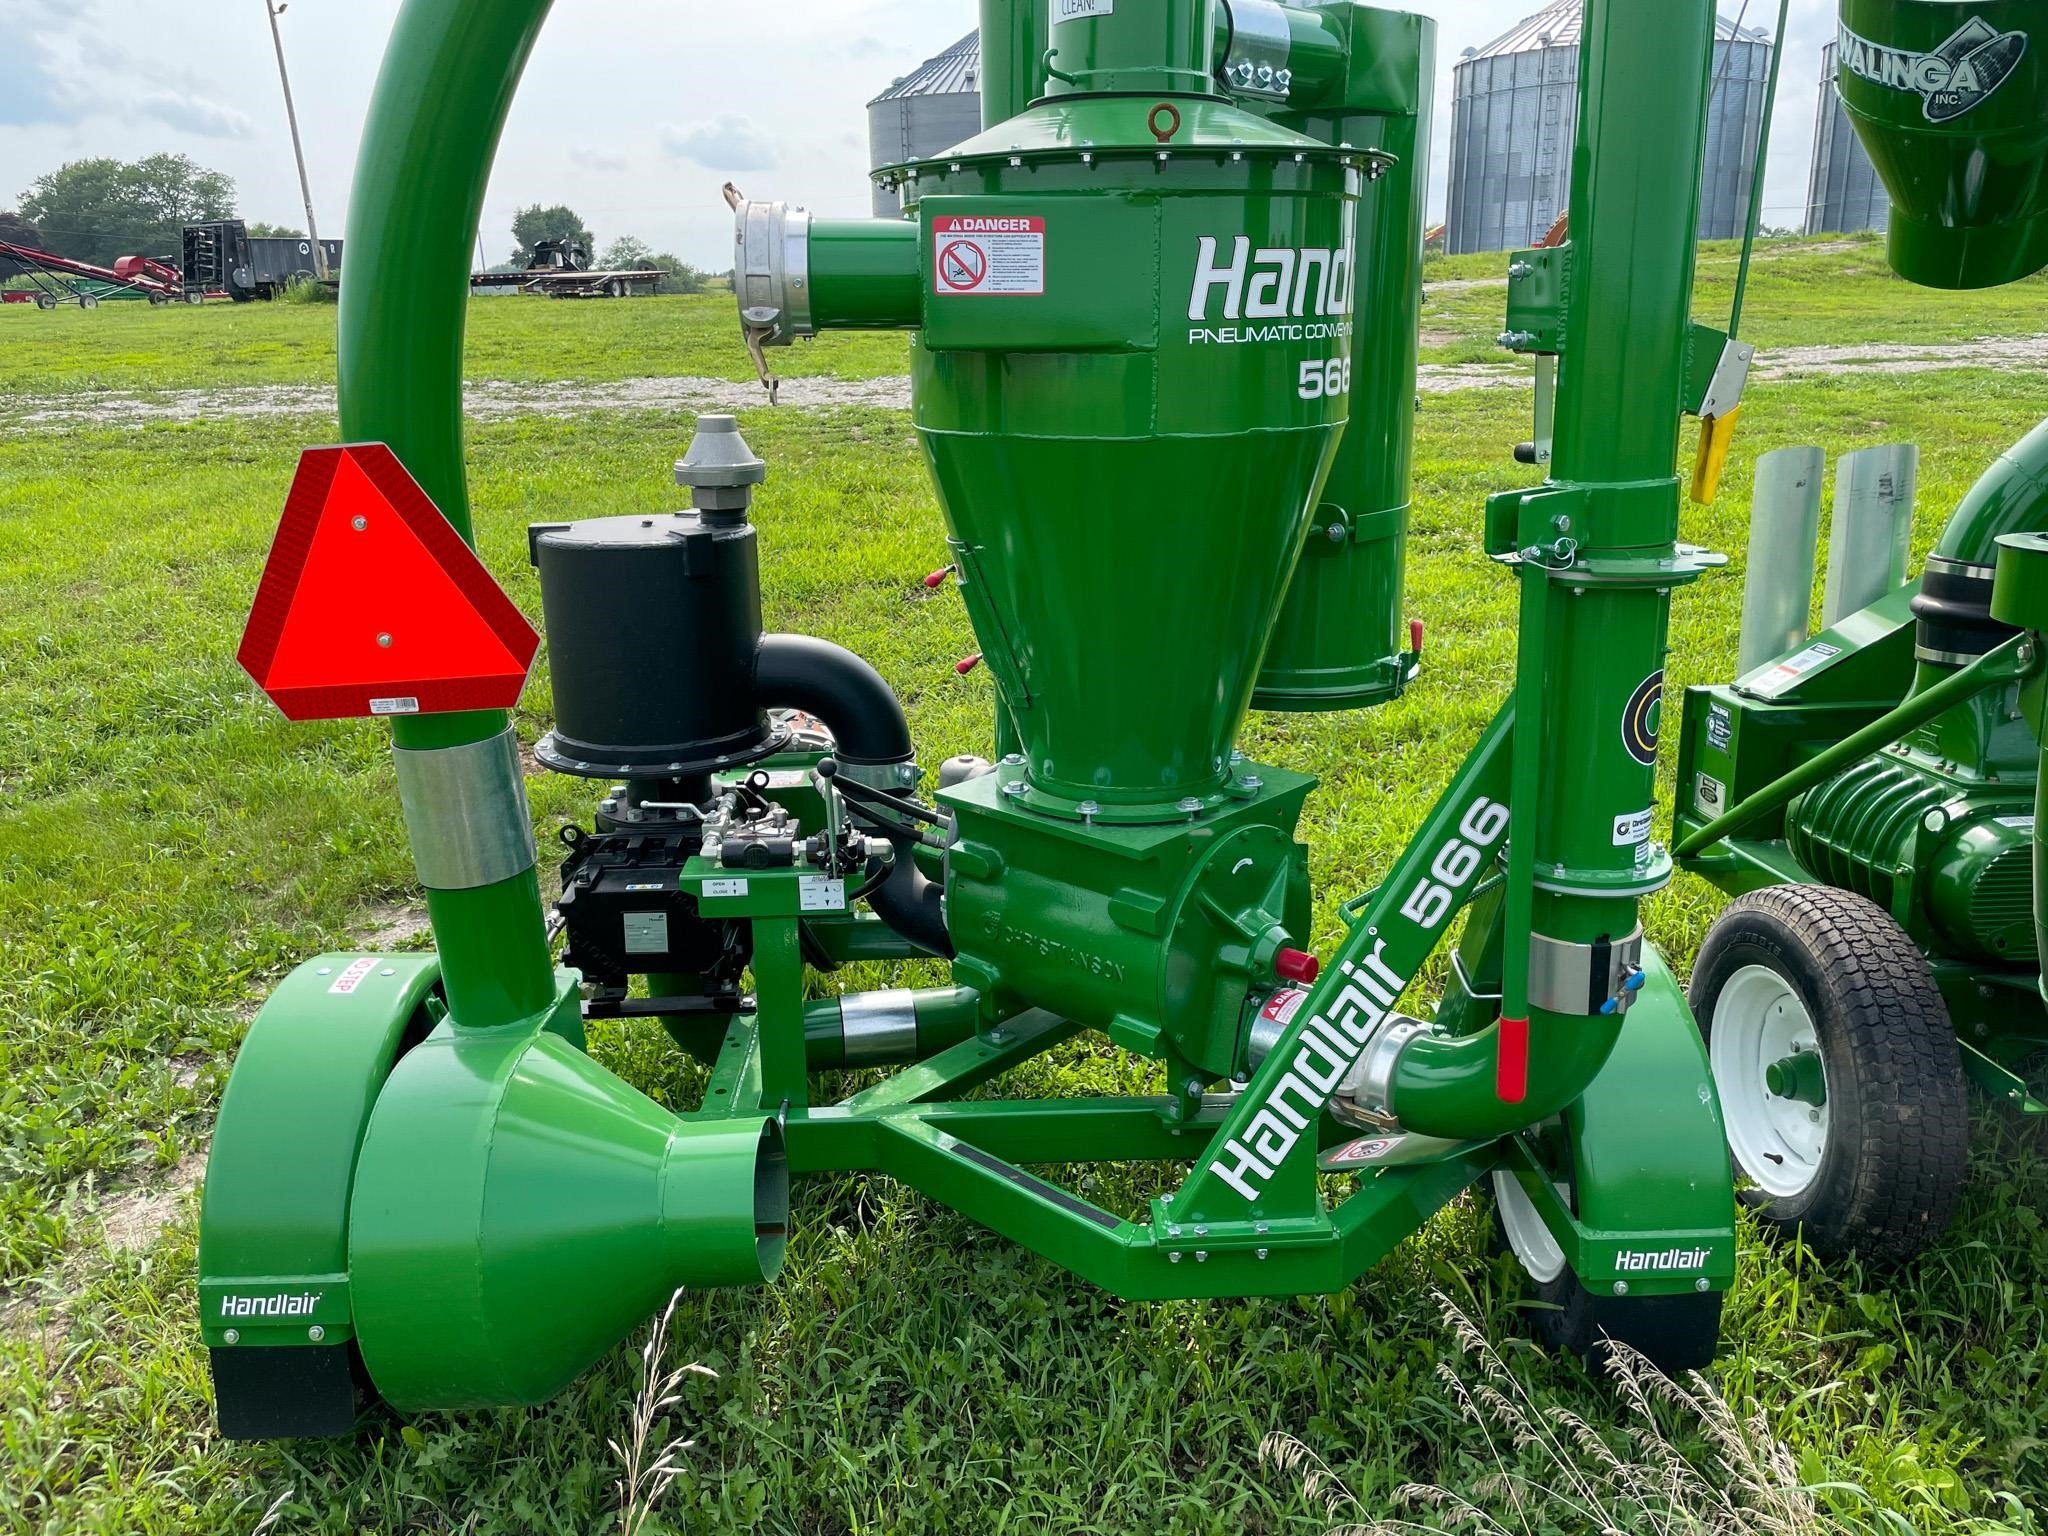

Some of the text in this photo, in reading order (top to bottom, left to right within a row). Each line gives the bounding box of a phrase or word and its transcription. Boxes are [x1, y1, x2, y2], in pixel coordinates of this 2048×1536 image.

[1838, 25, 1984, 93] WALINGA
[1935, 94, 1962, 105] INC.
[963, 219, 1030, 231] DANGER
[1189, 324, 1303, 345] PNEUMATIC
[1297, 356, 1351, 400] 566
[1399, 795, 1511, 930] 566
[1615, 1247, 1711, 1271] Handlair
[221, 1292, 321, 1316] Handlair
